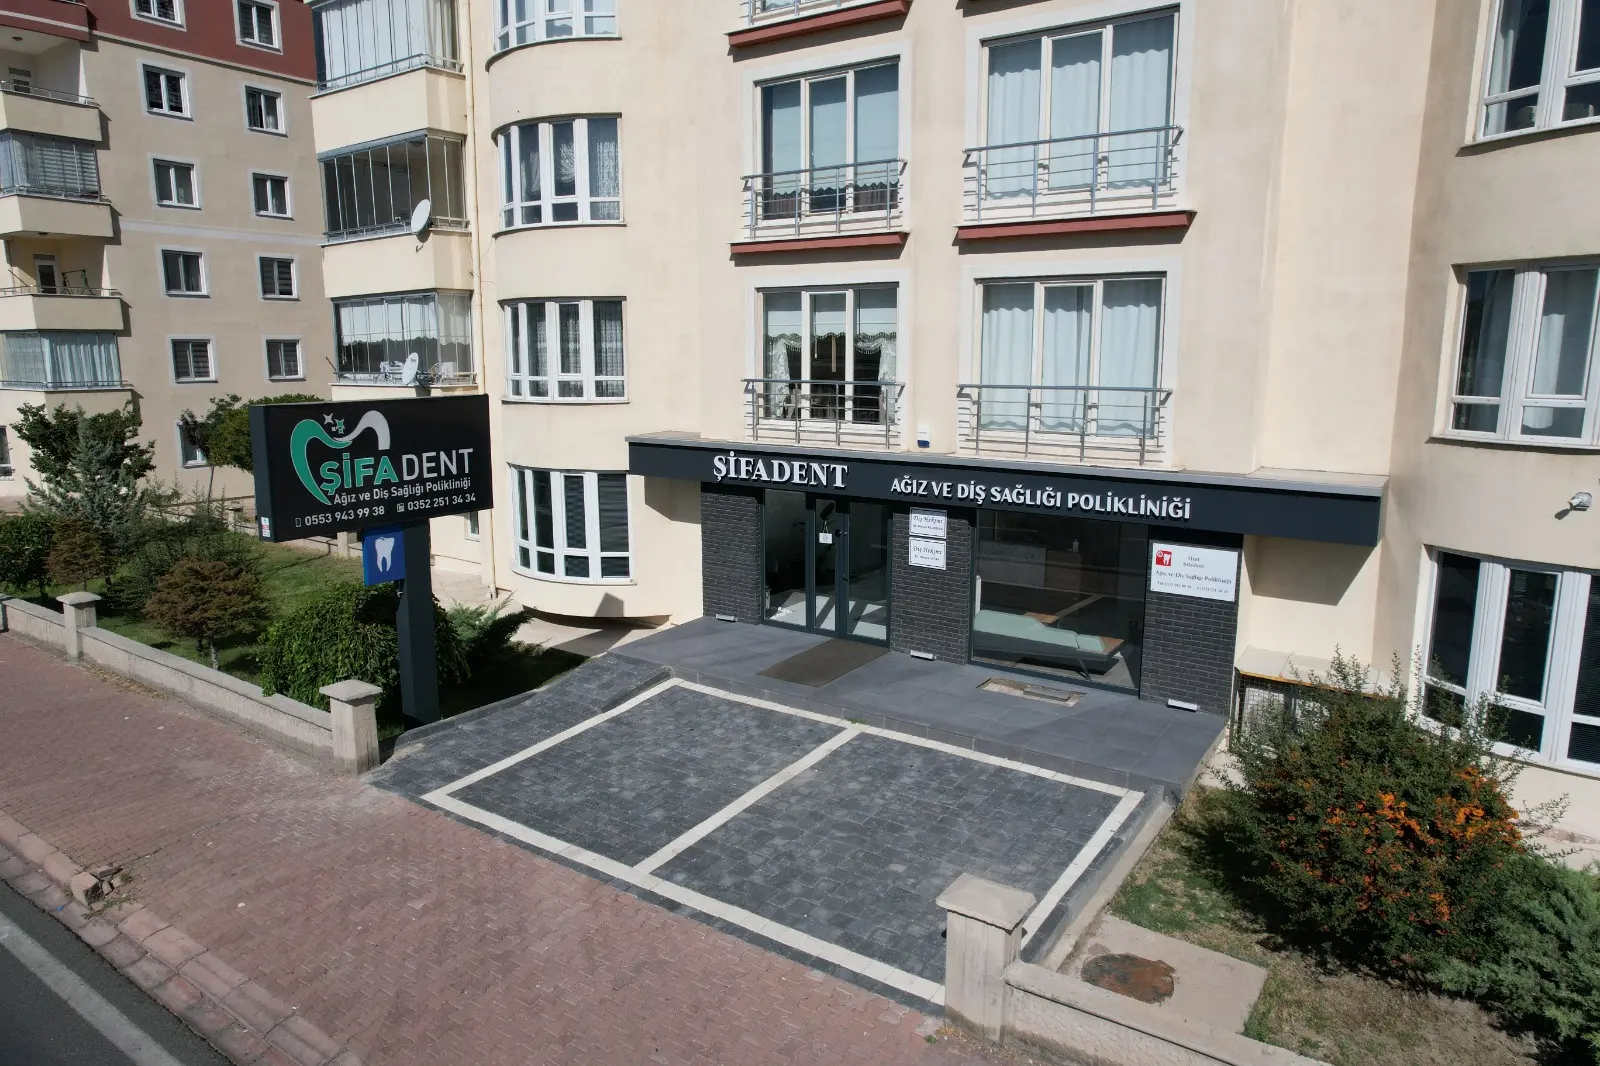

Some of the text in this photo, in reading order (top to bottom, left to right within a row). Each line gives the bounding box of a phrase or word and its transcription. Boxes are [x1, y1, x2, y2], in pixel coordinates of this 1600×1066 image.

[713, 451, 848, 488] ŞİFADENT
[334, 477, 471, 506] Ağız ve Diş Sağlığı Polikliniği
[408, 492, 476, 510] 0352 251 34 34
[891, 475, 1191, 519] AĞIZ VE DİŞ SAĞLIĞI POLİKLİNİĞİ
[305, 505, 385, 526] 0553 943 99 38
